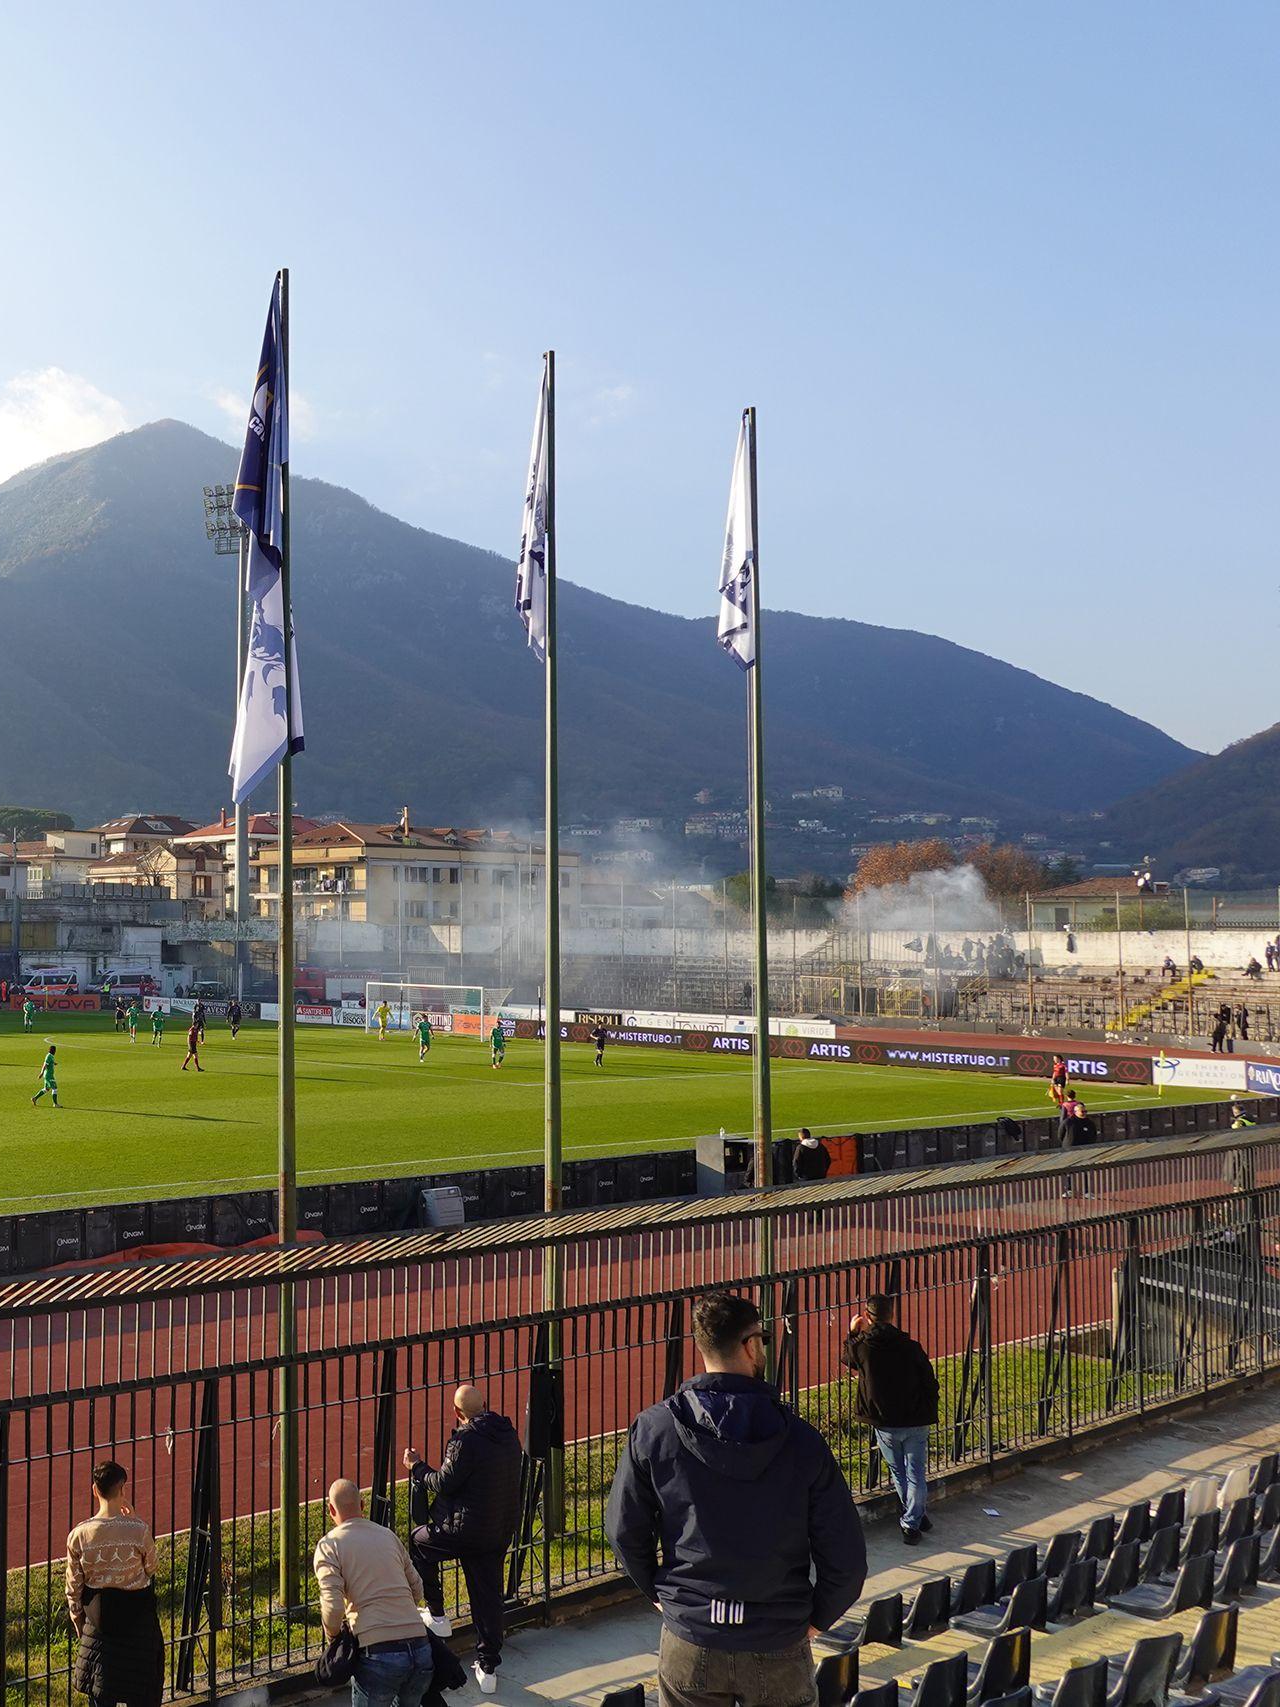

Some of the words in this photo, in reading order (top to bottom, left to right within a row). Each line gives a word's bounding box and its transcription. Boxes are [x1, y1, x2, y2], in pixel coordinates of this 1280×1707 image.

[578, 1014, 619, 1026] RISPOLI
[606, 1030, 682, 1044] W.MISTERTUBO.IT
[713, 1037, 750, 1050] ARTIS
[810, 1043, 851, 1058] ARTIS
[886, 1049, 1010, 1068] WWW.MISTERTUBO.IT
[1066, 1059, 1108, 1075] RTIS
